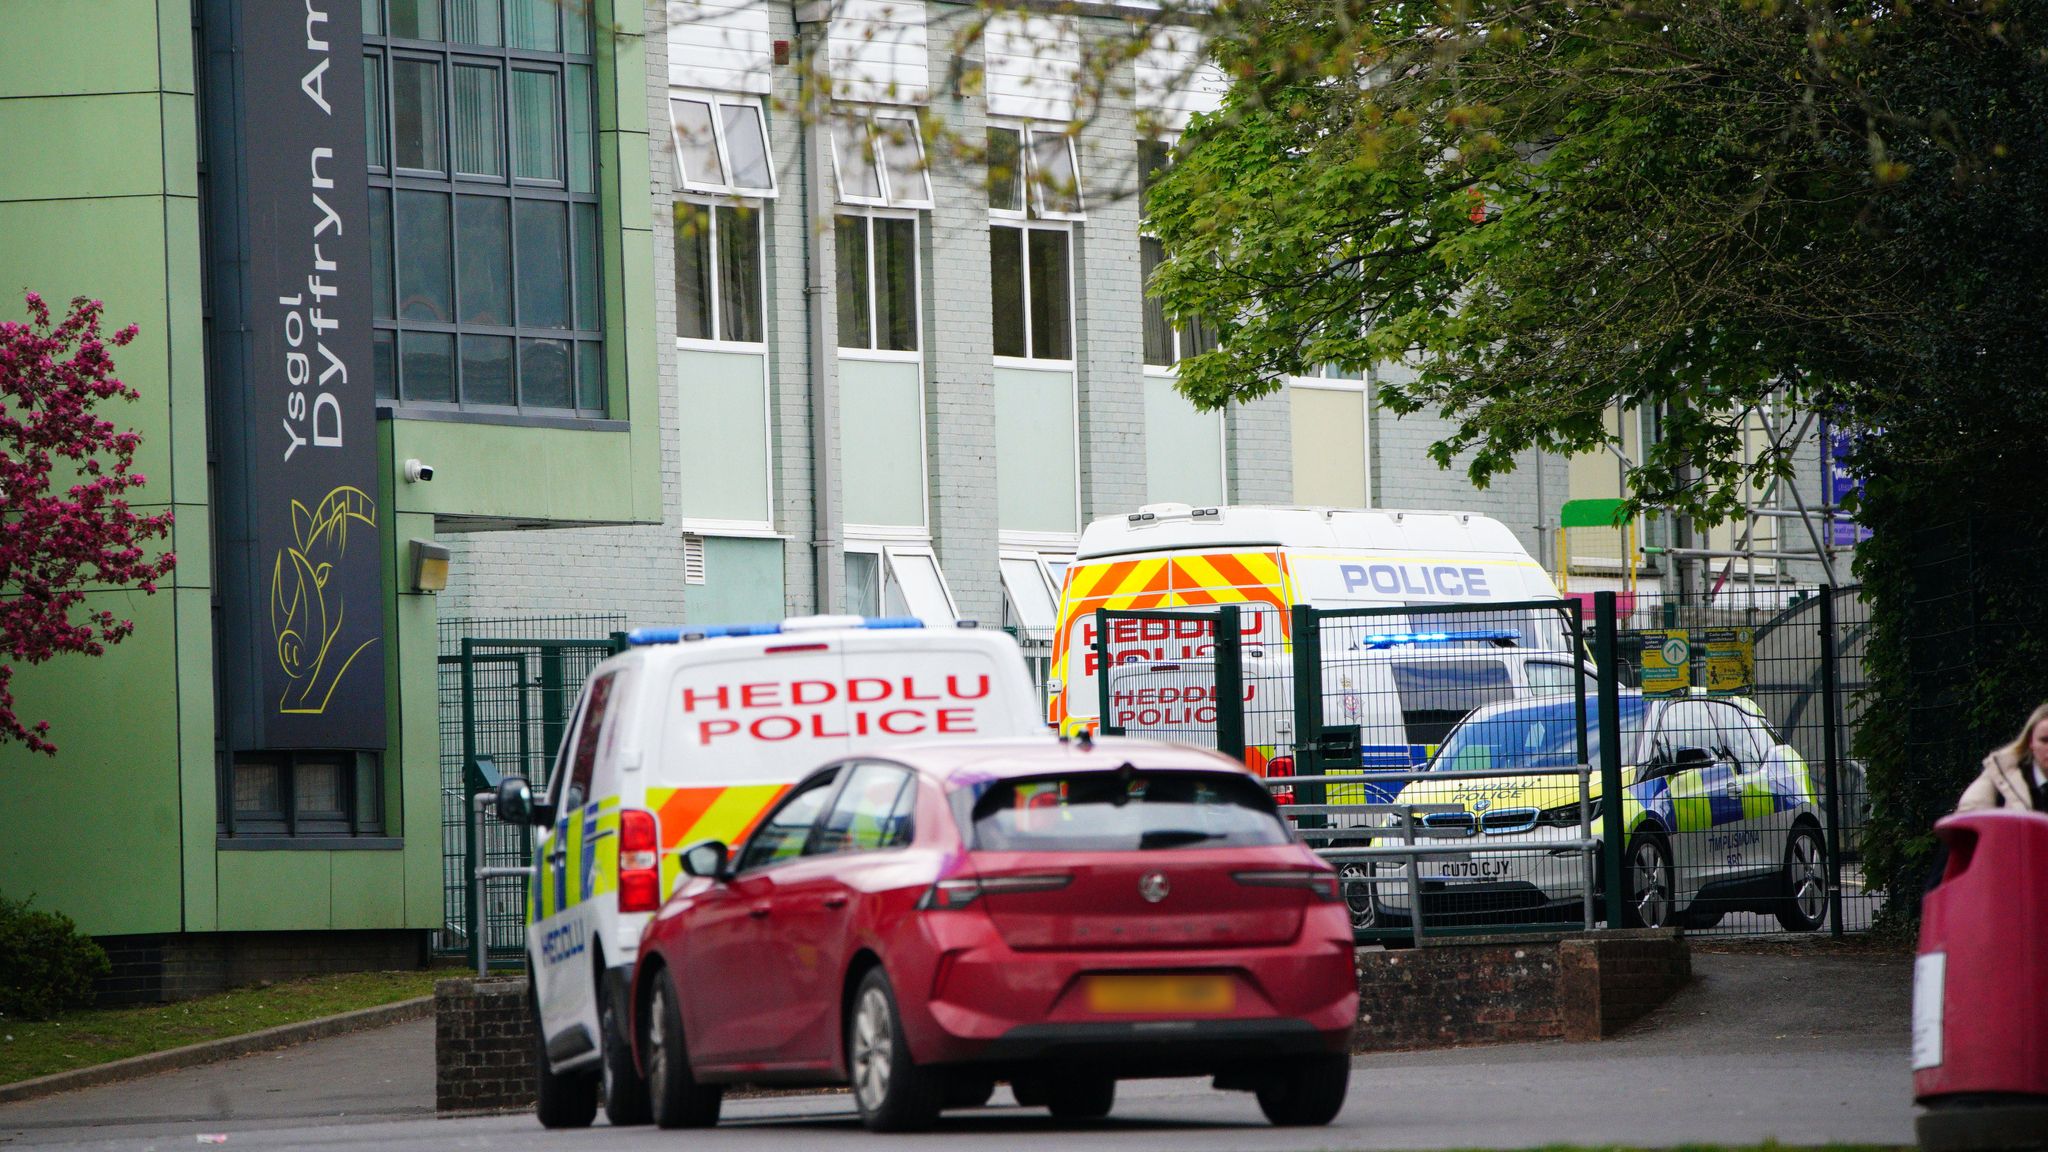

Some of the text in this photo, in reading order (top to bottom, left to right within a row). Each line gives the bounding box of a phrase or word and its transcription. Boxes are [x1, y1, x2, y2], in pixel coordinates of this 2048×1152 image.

[308, 146, 347, 449] Dyffryn
[279, 292, 310, 462] Ysgol
[1339, 564, 1492, 597] POLICE
[683, 674, 990, 712] HEDDLU
[699, 707, 978, 745] POLICE
[1452, 789, 1522, 802] POLICE
[1458, 781, 1535, 790] HEDDLU
[1442, 860, 1510, 877] CU70 CJY
